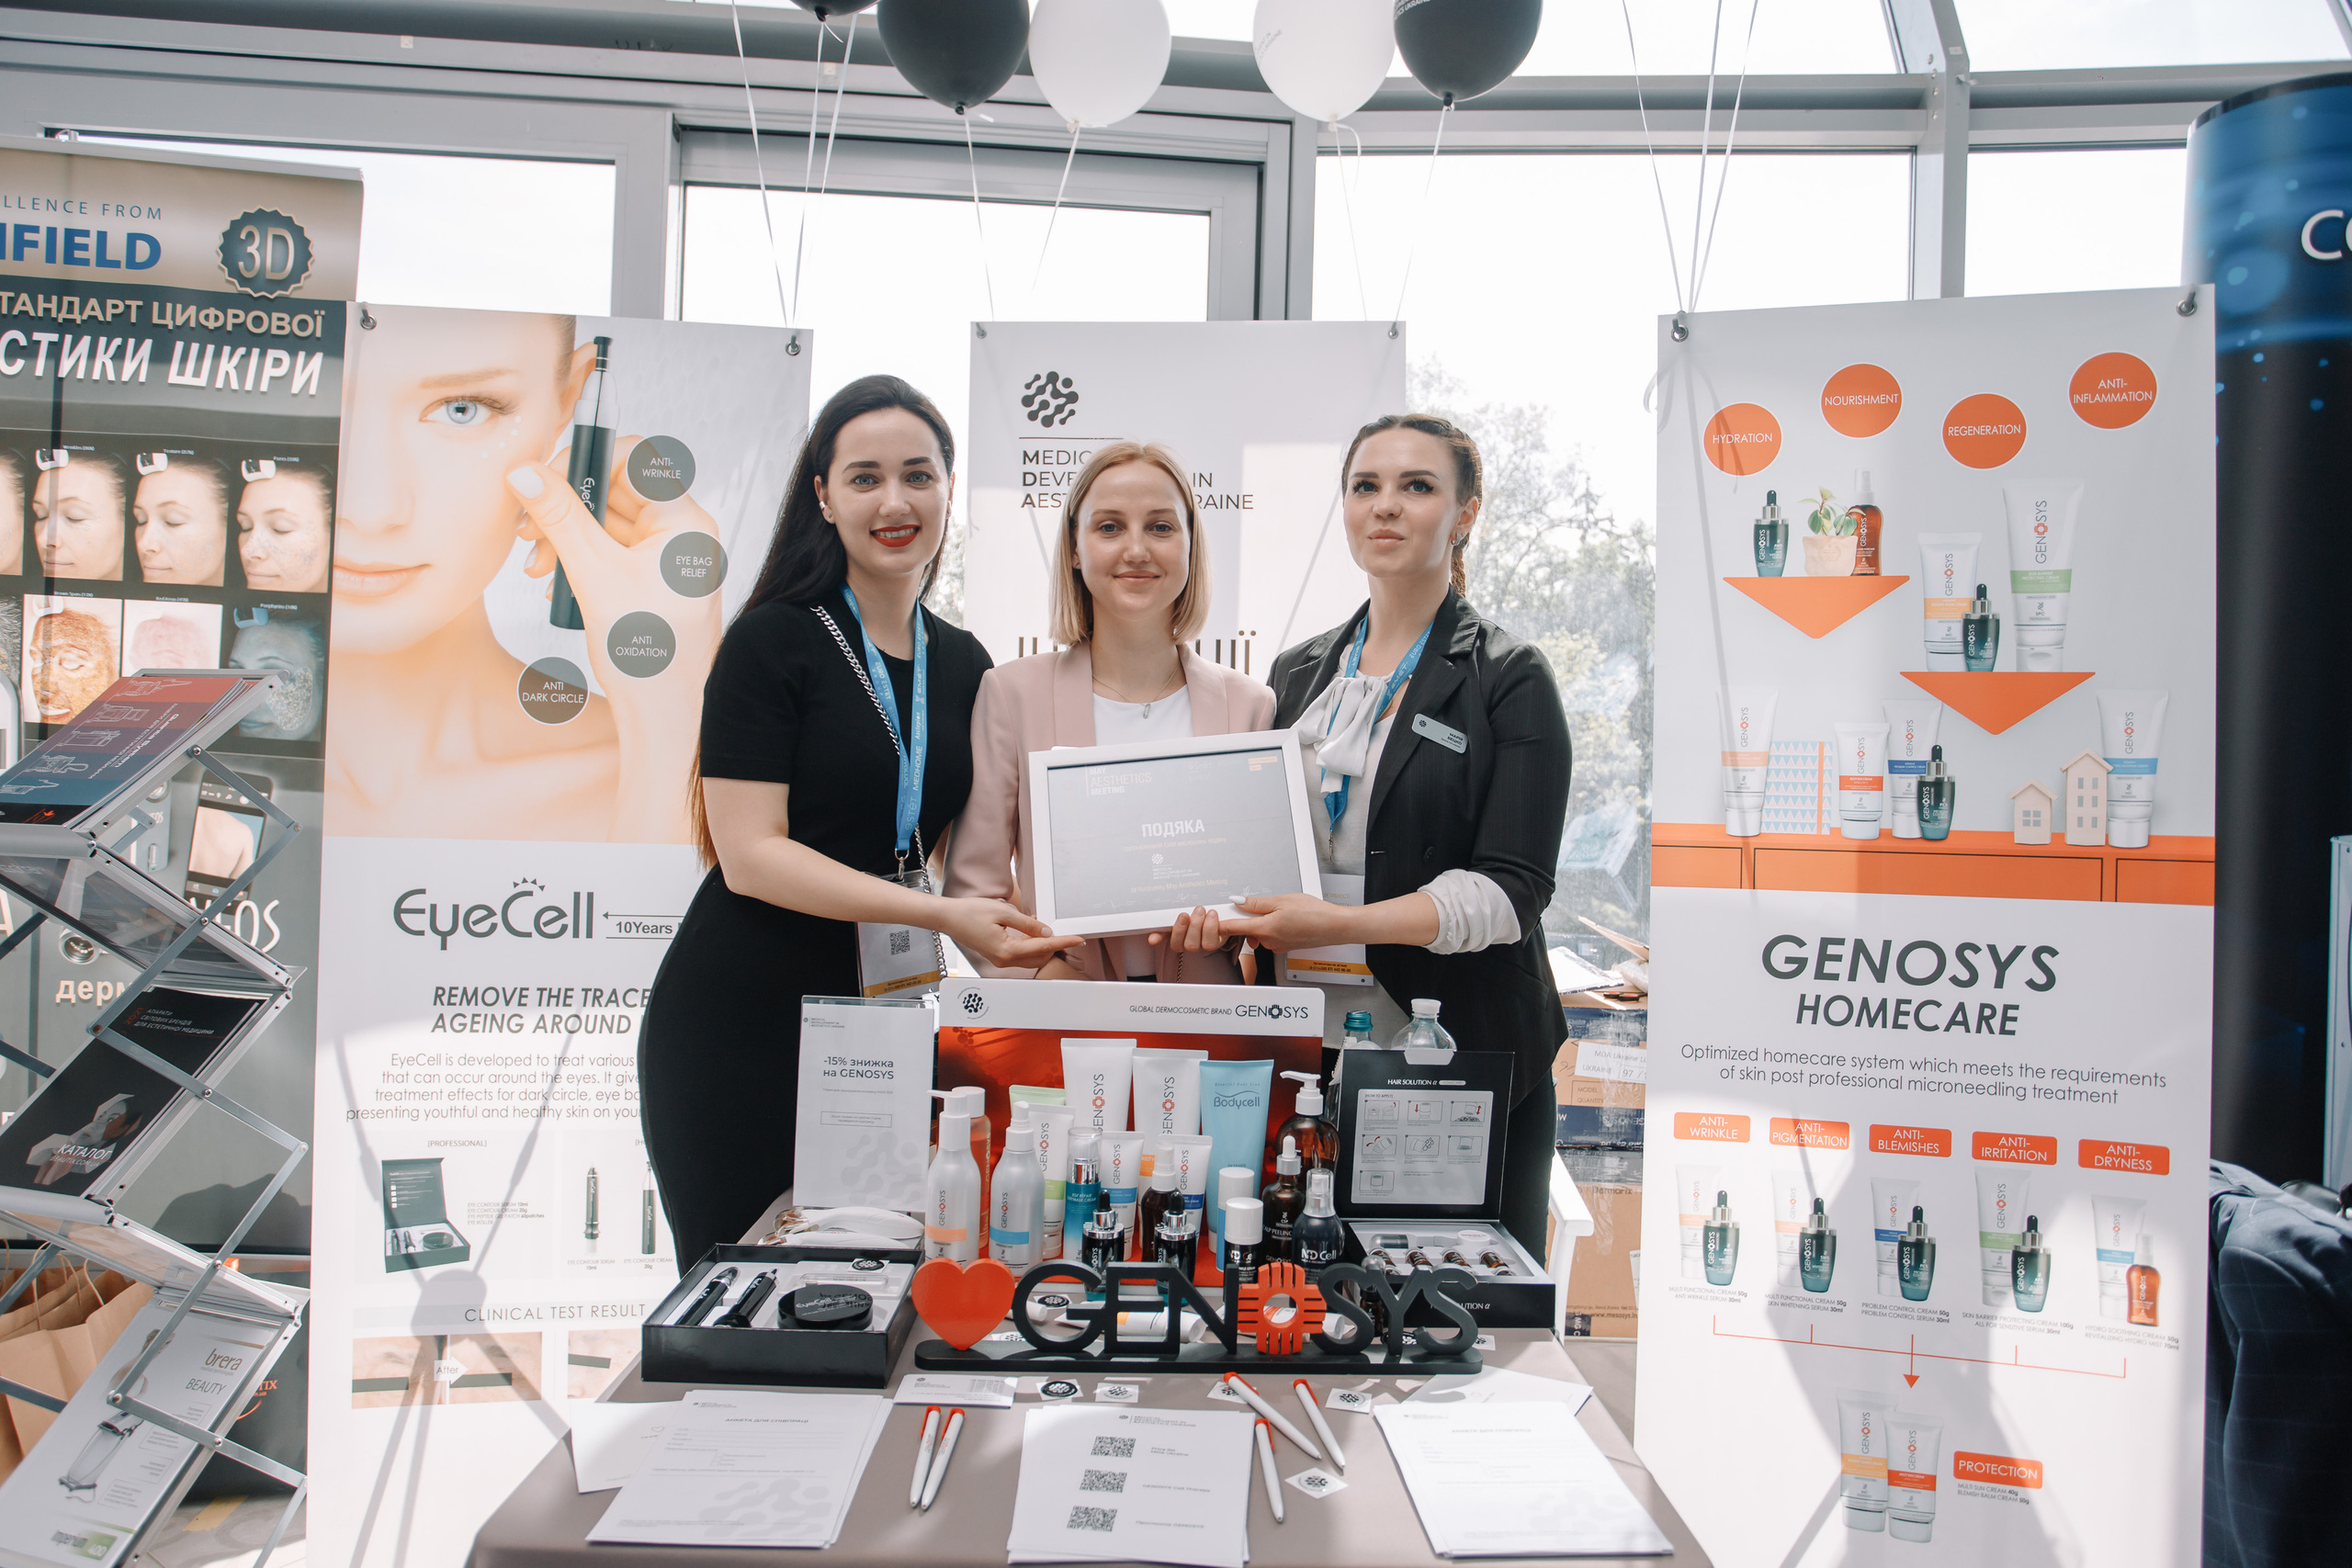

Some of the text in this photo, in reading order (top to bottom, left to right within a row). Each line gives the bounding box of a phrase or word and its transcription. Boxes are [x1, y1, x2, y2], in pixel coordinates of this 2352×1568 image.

[101, 203, 163, 220] FROM
[0, 222, 162, 271] FIELD
[237, 224, 295, 281] 3D
[152, 301, 326, 339] ЦИФРОВОЇ
[167, 341, 324, 397] ШКІРИ
[2098, 378, 2129, 389] ANTI-
[1824, 393, 1899, 408] NOURISHMENT
[2073, 389, 2154, 404] INFLAMMATION
[1712, 432, 1773, 445] HYDRATION
[1947, 423, 2021, 438] REGENERATION
[650, 457, 674, 467] ANTI-
[641, 467, 682, 480] WRINKLE
[1193, 471, 1214, 489] IN
[2033, 500, 2049, 564] GENOSYS
[675, 555, 714, 566] EYE BAG
[681, 567, 707, 579] RELIEF
[1944, 553, 1954, 596] GENOSYS
[631, 635, 653, 646] ANTI
[615, 646, 669, 659] OXIDATION
[1408, 644, 1422, 660] EURO
[542, 681, 564, 692] ANTI
[522, 692, 585, 705] DARK CIRCLE
[912, 745, 924, 793] MEDHOME
[1090, 767, 1106, 776] MAY
[1091, 772, 1153, 788] AESTHETICS
[1091, 785, 1125, 796] MEETING
[1141, 818, 1205, 839] ПОДЯКА
[392, 887, 595, 952] EyeCell
[615, 920, 673, 935] 10Years
[1761, 933, 2061, 993] GENOSYS
[432, 986, 530, 1008] REMOVE
[536, 987, 576, 1008] THE
[1129, 1003, 1309, 1021] GLOBAL DERMOCOSMETIC BRAND GENOSYS
[1795, 993, 2020, 1036] HOMECARE
[430, 1012, 633, 1035] AGEING AROUND
[390, 1053, 635, 1069] EyeCell is developed to treat various
[823, 1055, 894, 1068] -15% знижка
[1594, 1050, 1612, 1058] MDA
[822, 1068, 895, 1080] на GENOSYS
[1582, 1064, 1634, 1078] UKRAINE 97
[1680, 1043, 2167, 1089] Optimized homecare system which meets the requirements
[381, 1070, 411, 1085] that
[413, 1072, 441, 1085] can
[444, 1072, 483, 1085] occur
[488, 1070, 537, 1085] around
[540, 1070, 563, 1085] the
[566, 1072, 602, 1088] eyes.
[604, 1070, 612, 1085] It
[1719, 1066, 2119, 1104] of skin post professional microneedling treatment
[375, 1088, 621, 1106] treatment effects for dark circle, eye
[1213, 1096, 1261, 1110] Bodycell
[345, 1105, 612, 1123] presenting youthful and healthy skin on
[1699, 1116, 1729, 1126] ANTI-
[1690, 1126, 1738, 1140] WRINKLE
[1794, 1122, 1826, 1134] ANTI-
[1893, 1129, 1925, 1140] ANTI-
[1771, 1132, 1848, 1147] PIGMENTATION
[1878, 1139, 1939, 1154] BLEMISHES
[1997, 1136, 2031, 1147] ANTI-
[57, 1144, 114, 1160] КАТАЛОГ
[1981, 1146, 2048, 1162] IRRITATION
[2106, 1145, 2141, 1156] ANTI-
[1113, 1144, 1121, 1185] GENOSYS
[1180, 1149, 1190, 1190] GENOSYS
[2093, 1156, 2153, 1171] DRYNESS
[1591, 1185, 1633, 1196] DermaFix
[938, 1190, 946, 1226] GENOSYS
[1001, 1191, 1009, 1229] GENOSYS
[1319, 1248, 1338, 1261] Cell
[464, 1303, 647, 1323] CLINICAL TEST RESULT
[1012, 1260, 1479, 1357] GENOSYS
[1861, 1302, 1888, 1311] PROBLEM
[1888, 1303, 1917, 1313] CONTROL
[1917, 1306, 1939, 1315] CREAM
[205, 1348, 243, 1371] brera
[435, 1364, 459, 1376] After
[185, 1378, 228, 1395] BEAUTY
[1958, 1459, 2039, 1481] PROTECTION
